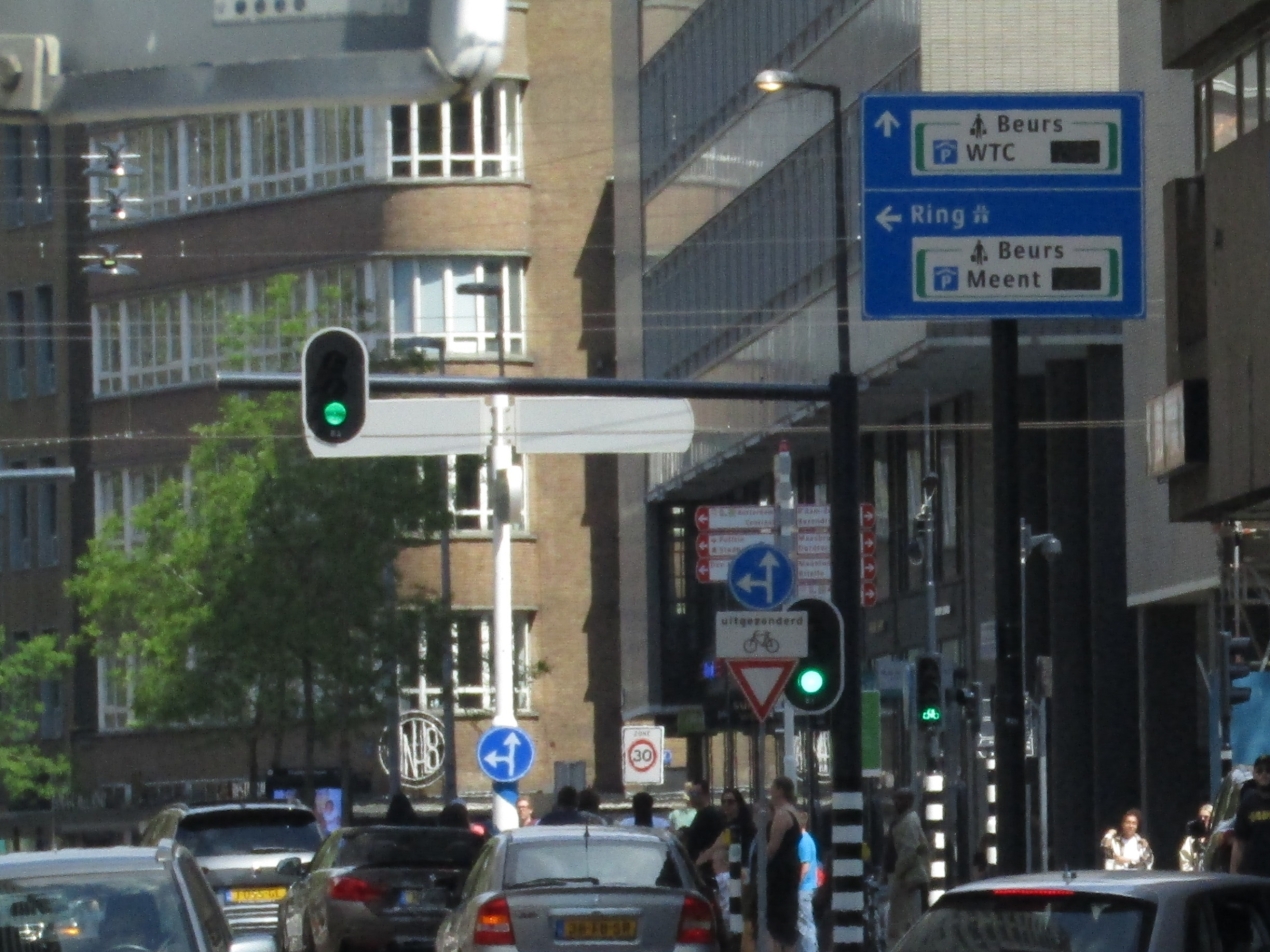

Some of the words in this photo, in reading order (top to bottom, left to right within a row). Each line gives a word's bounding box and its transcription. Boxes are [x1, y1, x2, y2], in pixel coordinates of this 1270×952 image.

[998, 114, 1063, 133] Beurs
[966, 143, 1016, 162] WTC
[911, 204, 965, 229] Ring
[998, 241, 1064, 259] Beurs
[967, 270, 1041, 288] Meent
[721, 616, 803, 627] uitgezonderd
[633, 750, 652, 762] 30
